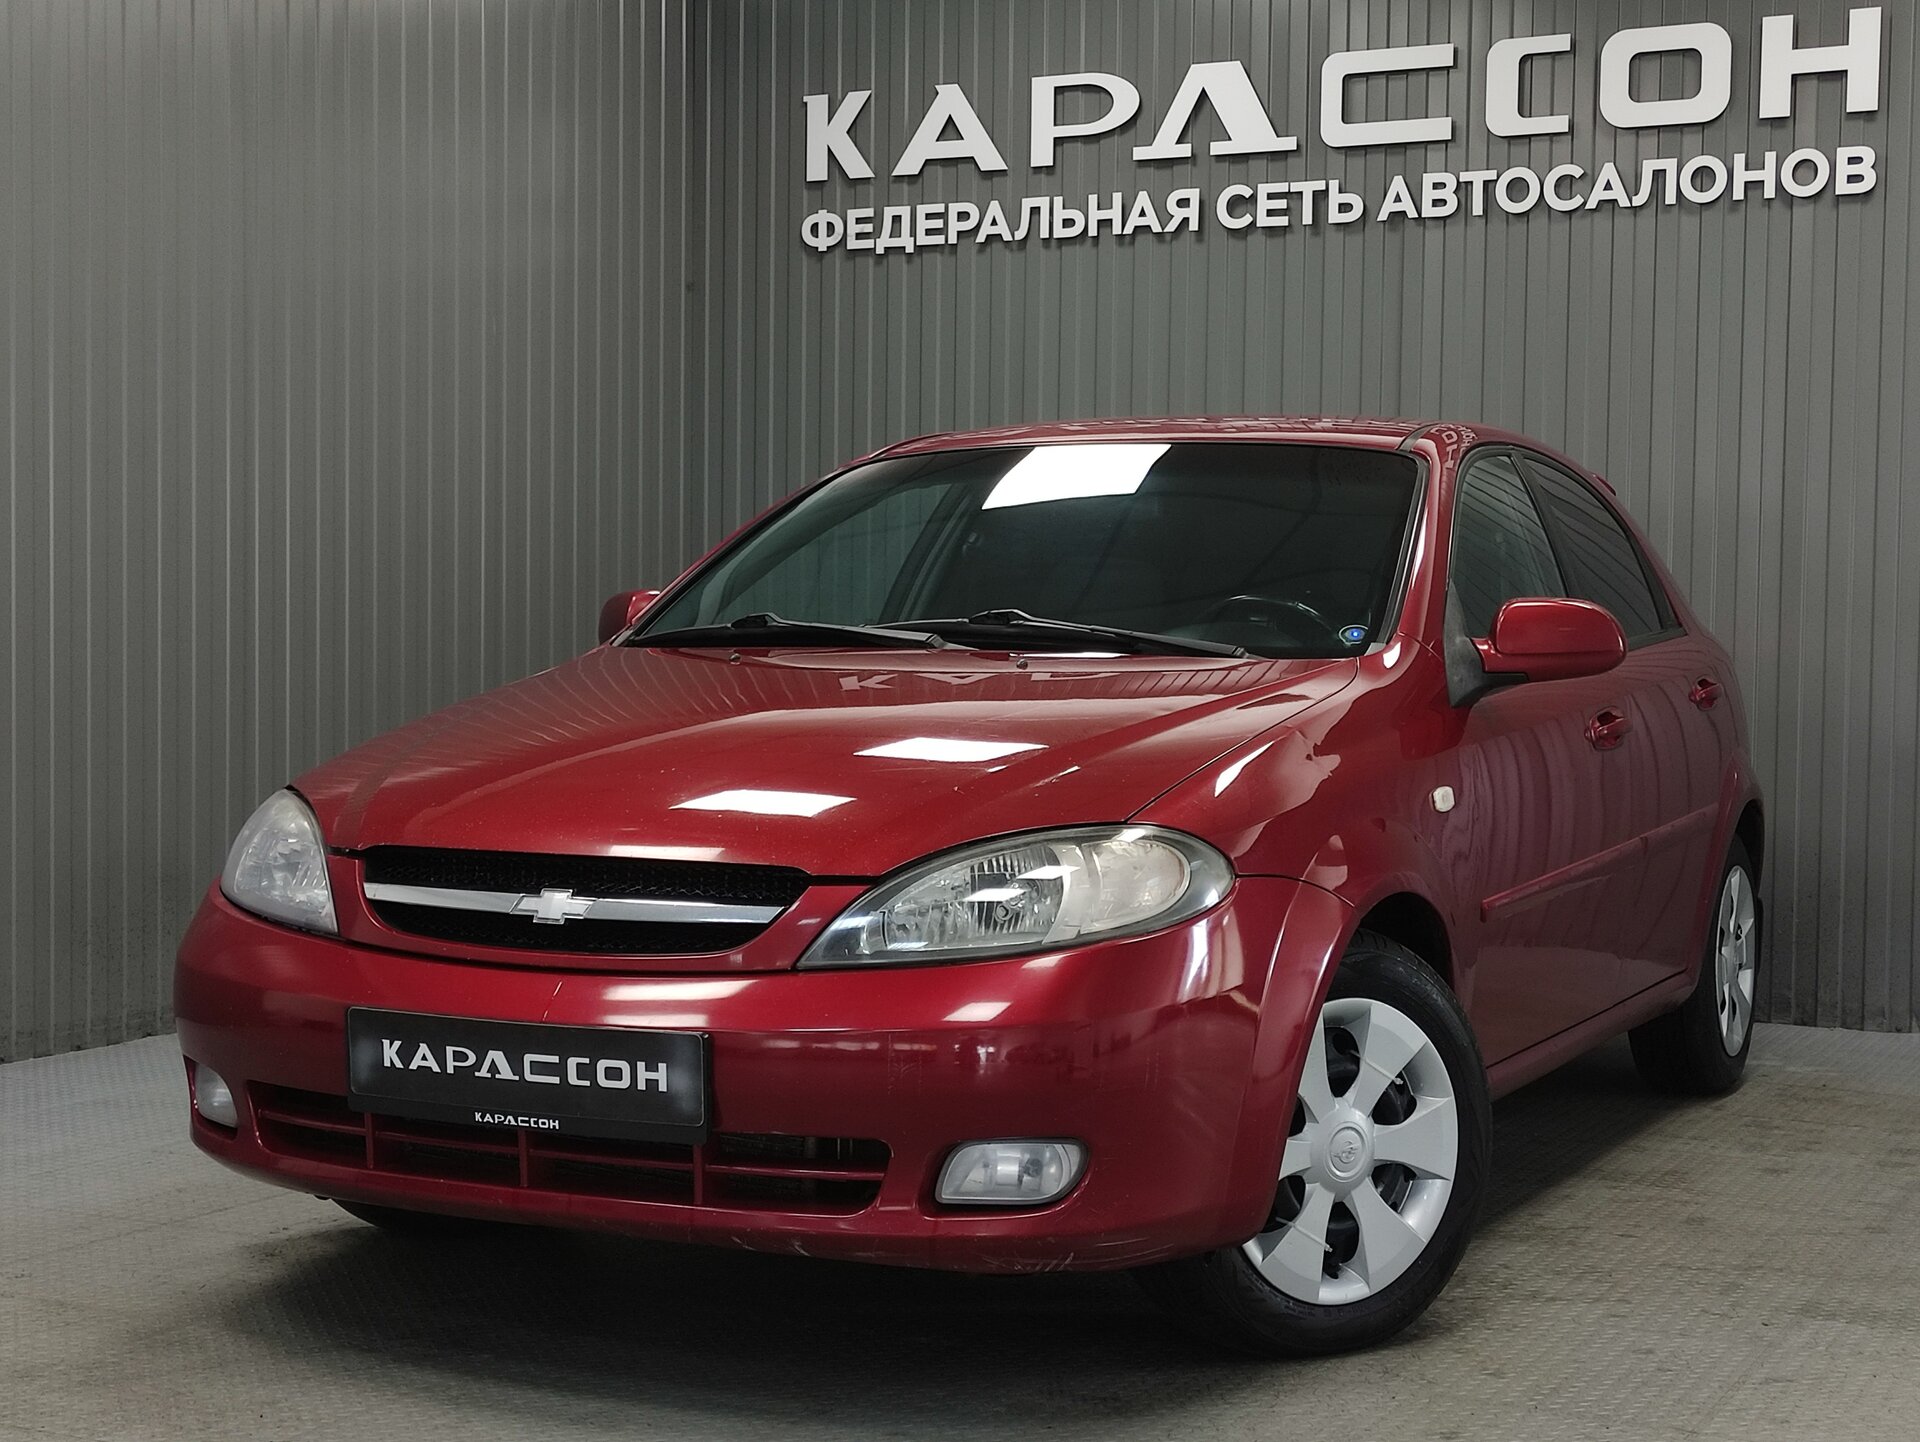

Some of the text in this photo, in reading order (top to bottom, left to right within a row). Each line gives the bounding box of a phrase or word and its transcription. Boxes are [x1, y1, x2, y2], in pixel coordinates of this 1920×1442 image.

[801, 145, 1877, 254] ФЕДЕРАЛЬНАЯ СЕТЬ АВТОСАЛОНОВ
